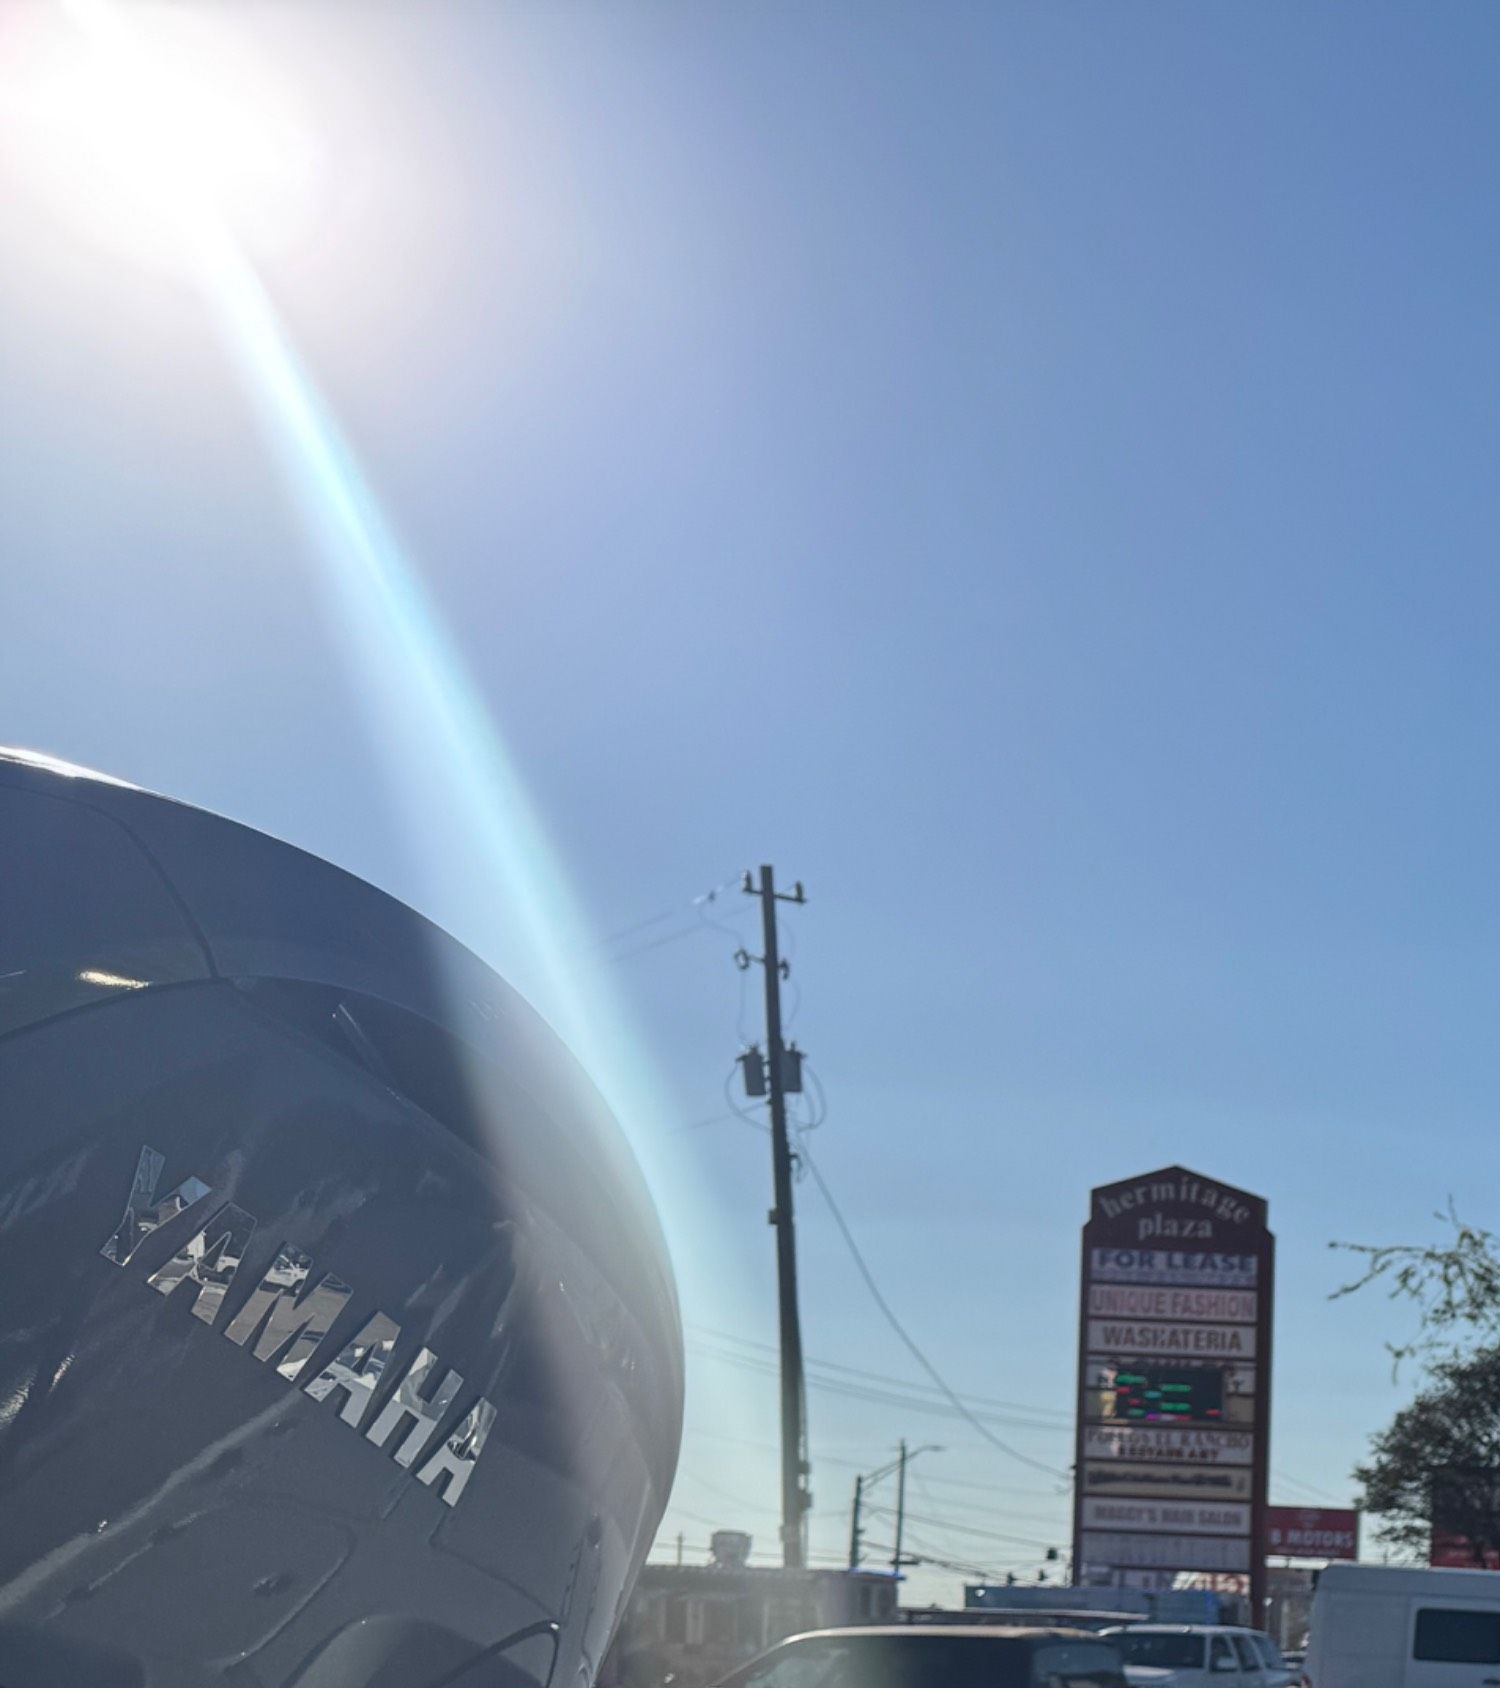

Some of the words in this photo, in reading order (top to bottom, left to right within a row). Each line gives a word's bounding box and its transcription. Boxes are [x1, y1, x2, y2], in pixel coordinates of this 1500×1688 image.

[1100, 1176, 1250, 1224] hermitage
[1138, 1212, 1214, 1241] plaza
[1098, 1250, 1154, 1269] FOR
[1167, 1252, 1254, 1272] LEASE
[1171, 1292, 1255, 1318] FASHION
[99, 1145, 497, 1507] YAMAHA
[1287, 1529, 1354, 1549] MOTORS
